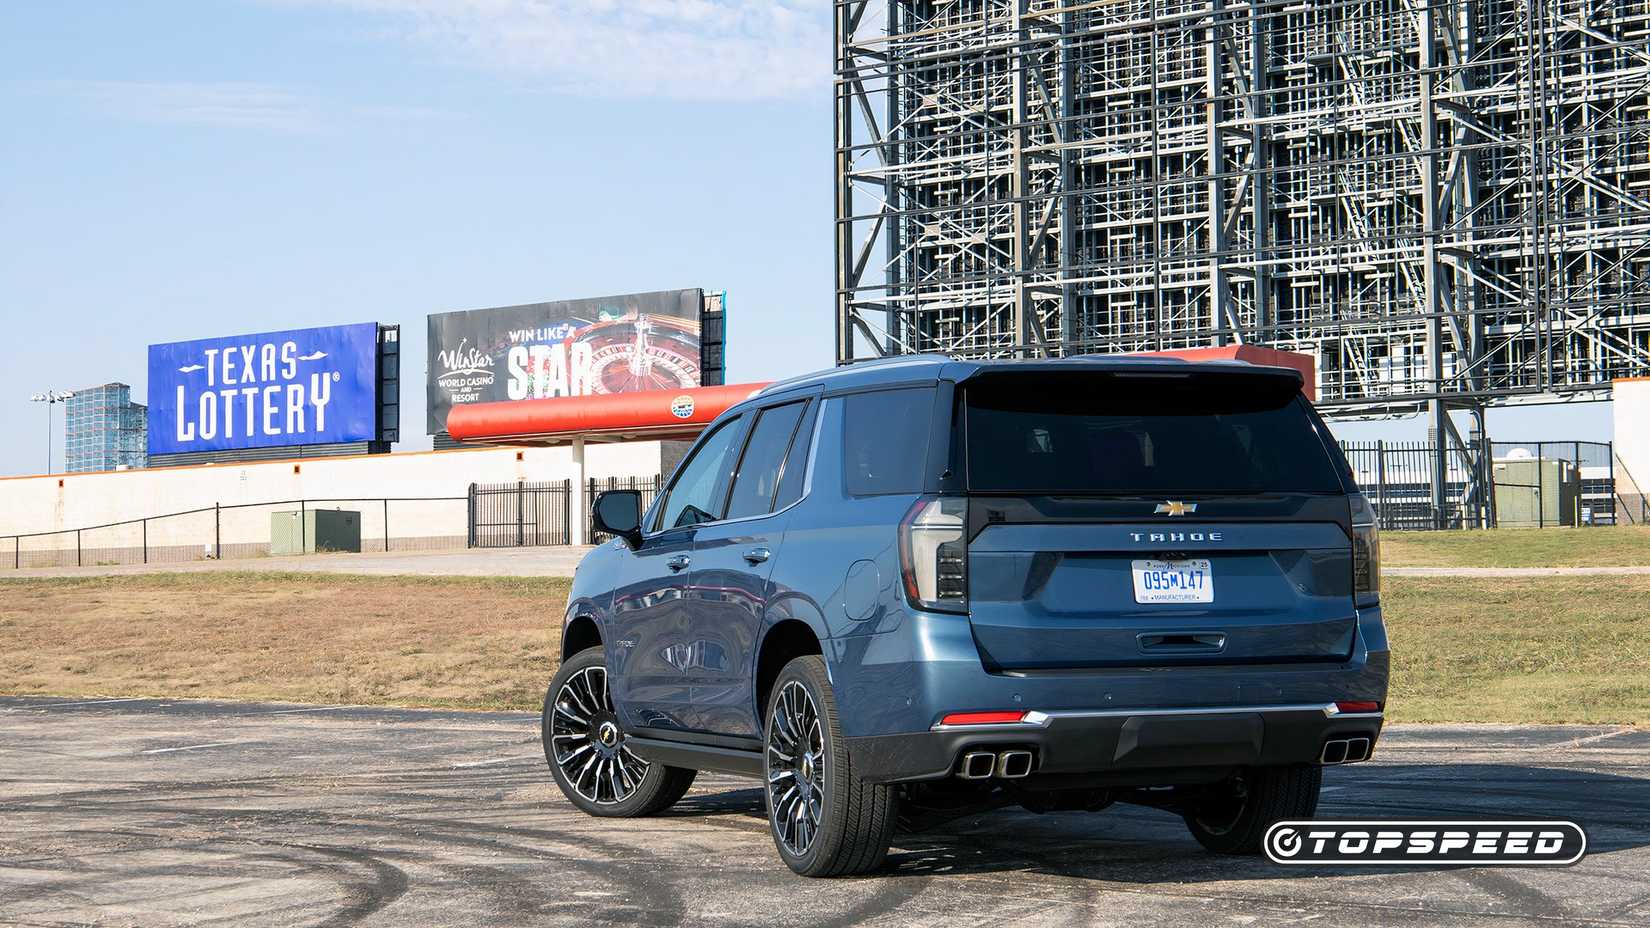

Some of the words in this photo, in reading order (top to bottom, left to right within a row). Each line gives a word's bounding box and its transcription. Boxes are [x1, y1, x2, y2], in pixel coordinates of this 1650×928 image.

[508, 329, 535, 343] WIN
[537, 326, 565, 341] LIKE
[204, 341, 297, 386] TEXAS
[437, 340, 496, 371] WinStar
[438, 378, 466, 387] WORLD
[467, 376, 494, 386] CASINO
[507, 341, 593, 400] STAR
[176, 372, 332, 442] LOTTERY
[451, 393, 479, 402] RESORT
[1130, 532, 1224, 542] TAHOE
